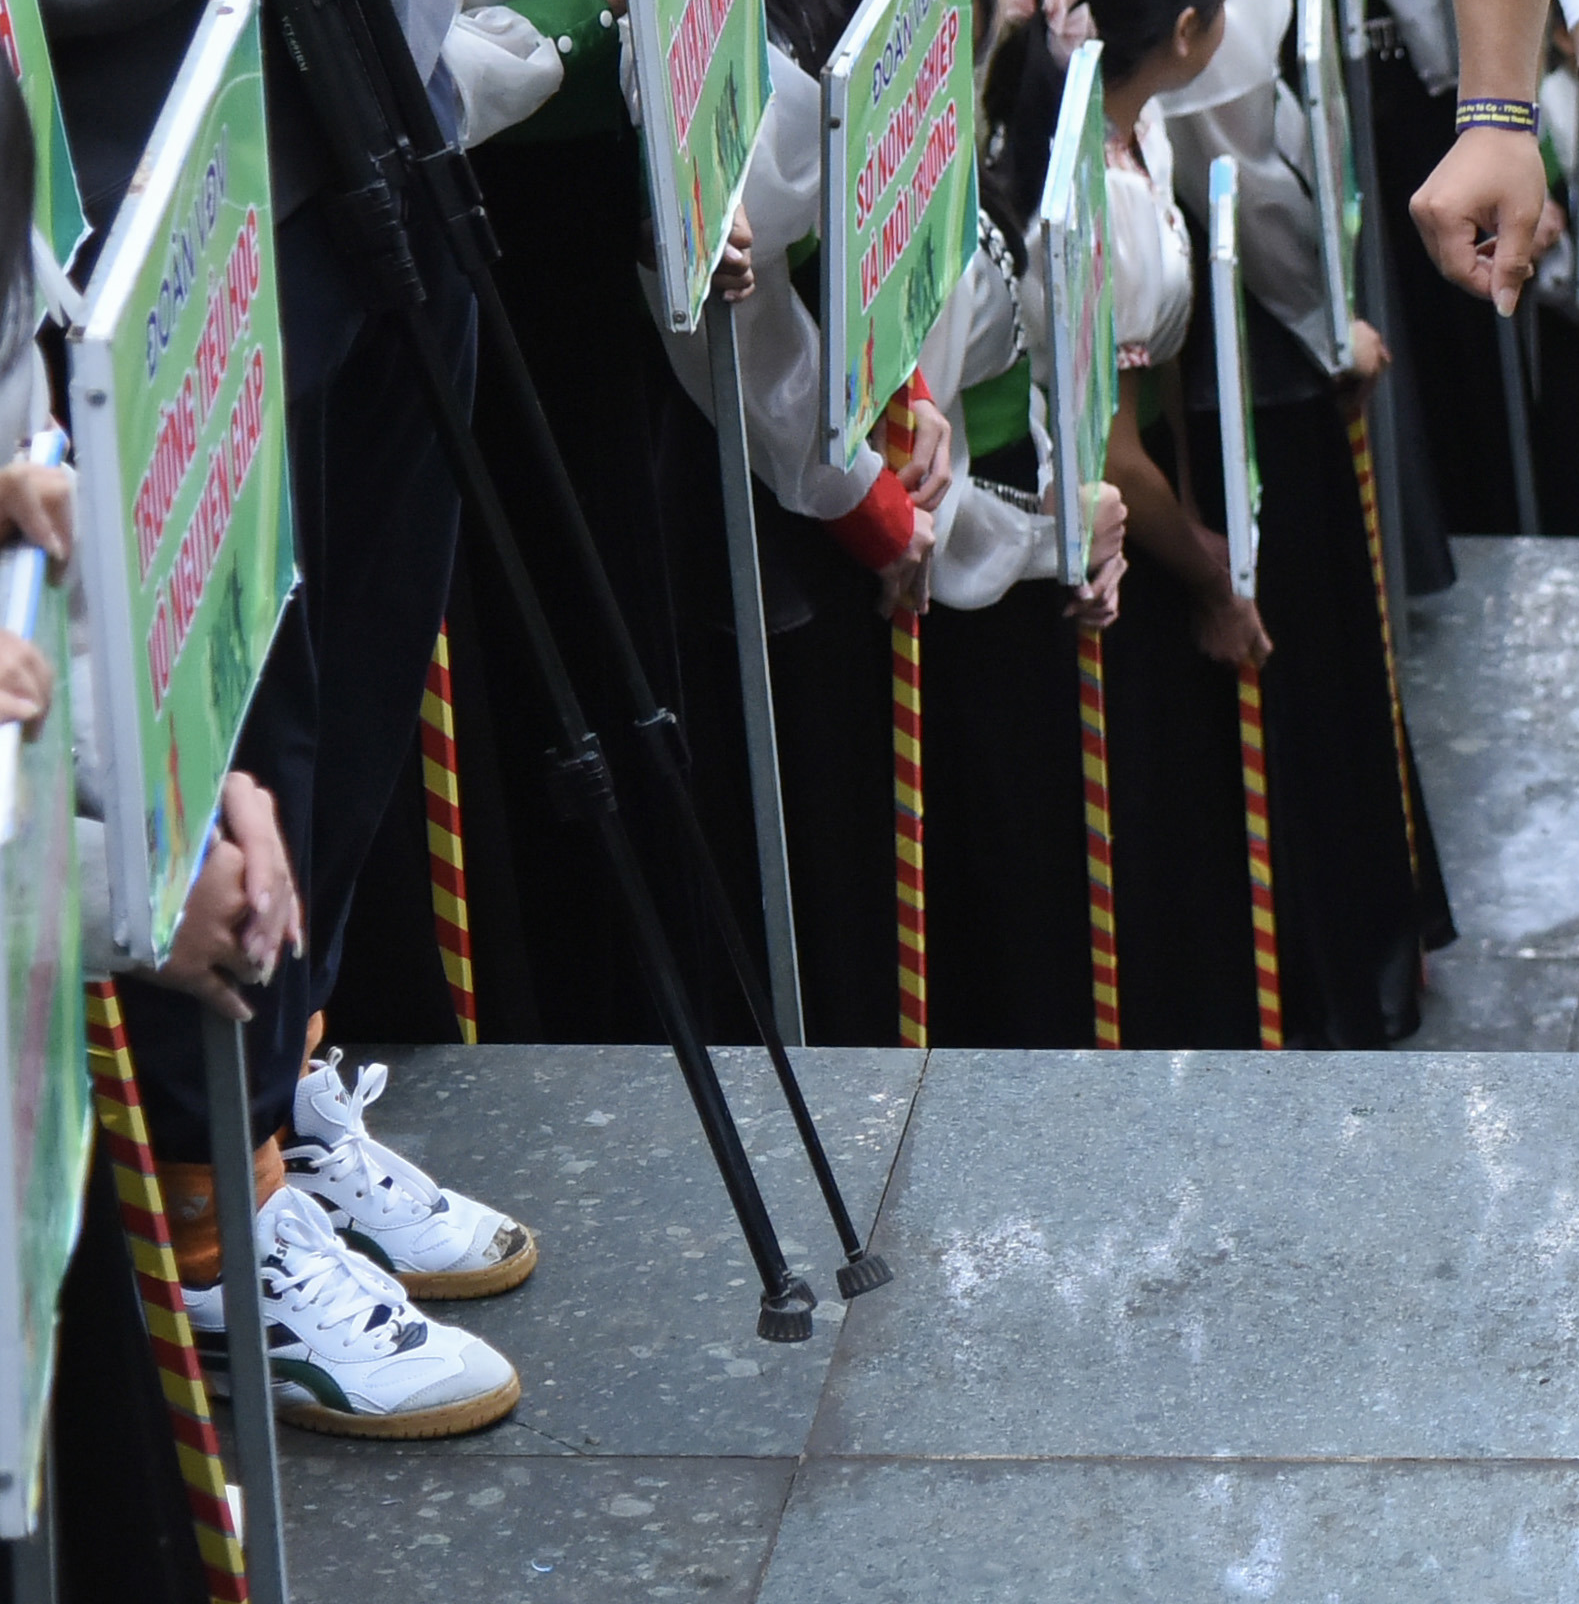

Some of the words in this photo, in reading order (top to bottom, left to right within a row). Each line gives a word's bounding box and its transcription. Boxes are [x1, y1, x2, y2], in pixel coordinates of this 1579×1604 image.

[854, 131, 877, 234] SỞ
[876, 86, 916, 201] NÔNG
[914, 4, 960, 129] NGHIỆP
[872, 9, 913, 107] ĐOÀN
[857, 227, 881, 314] VÀ
[880, 184, 912, 280] MÔI
[910, 98, 958, 233] TRƯỜNG
[132, 367, 197, 591] TRƯỜNG
[225, 202, 261, 353] HỌC
[146, 225, 197, 386] ĐOÀN
[229, 341, 265, 501] GIÁP
